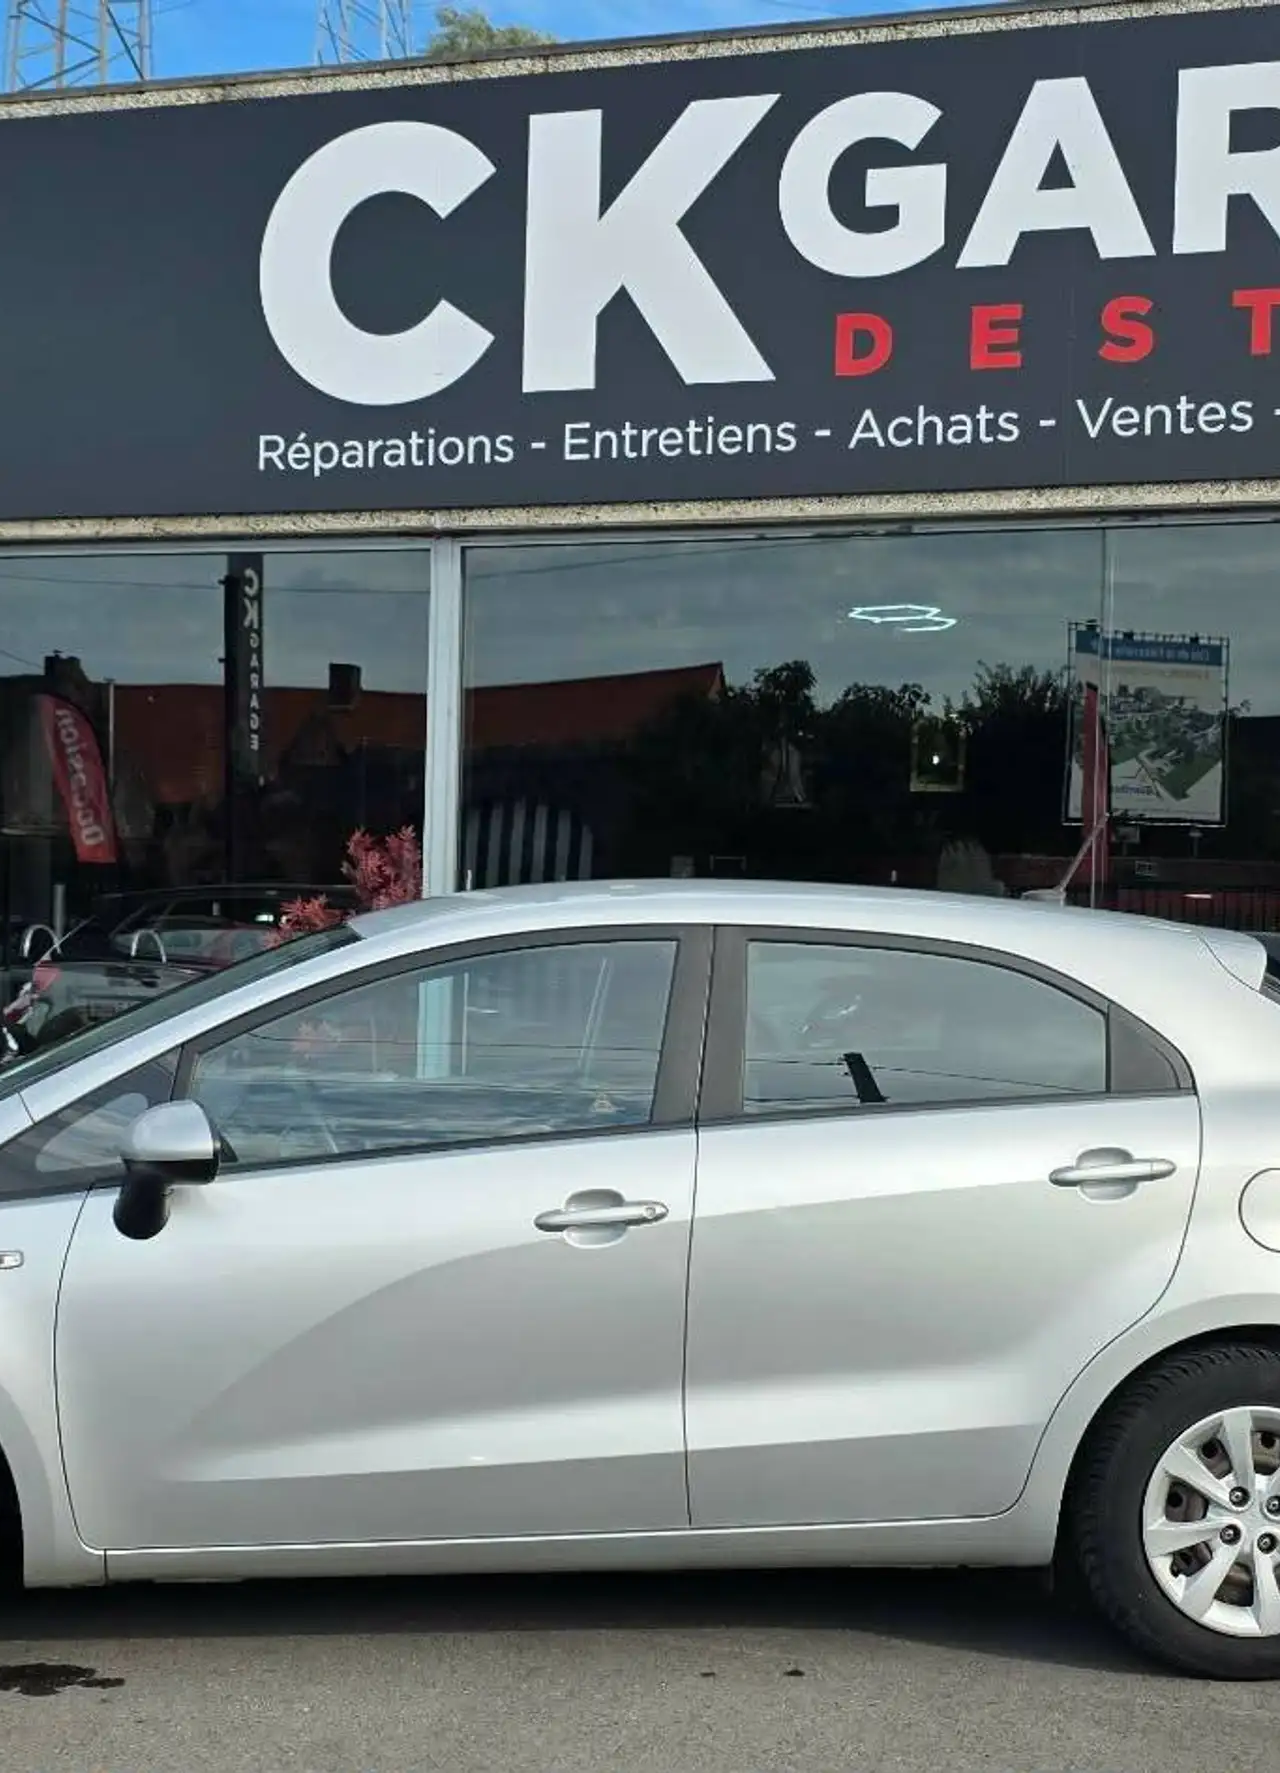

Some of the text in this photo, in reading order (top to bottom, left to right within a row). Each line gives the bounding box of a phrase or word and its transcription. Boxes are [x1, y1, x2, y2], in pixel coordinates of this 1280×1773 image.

[258, 434, 515, 477] Réparations
[564, 419, 797, 461] Entretiens
[848, 404, 1020, 449] Achats
[1076, 395, 1253, 438] Ventes
